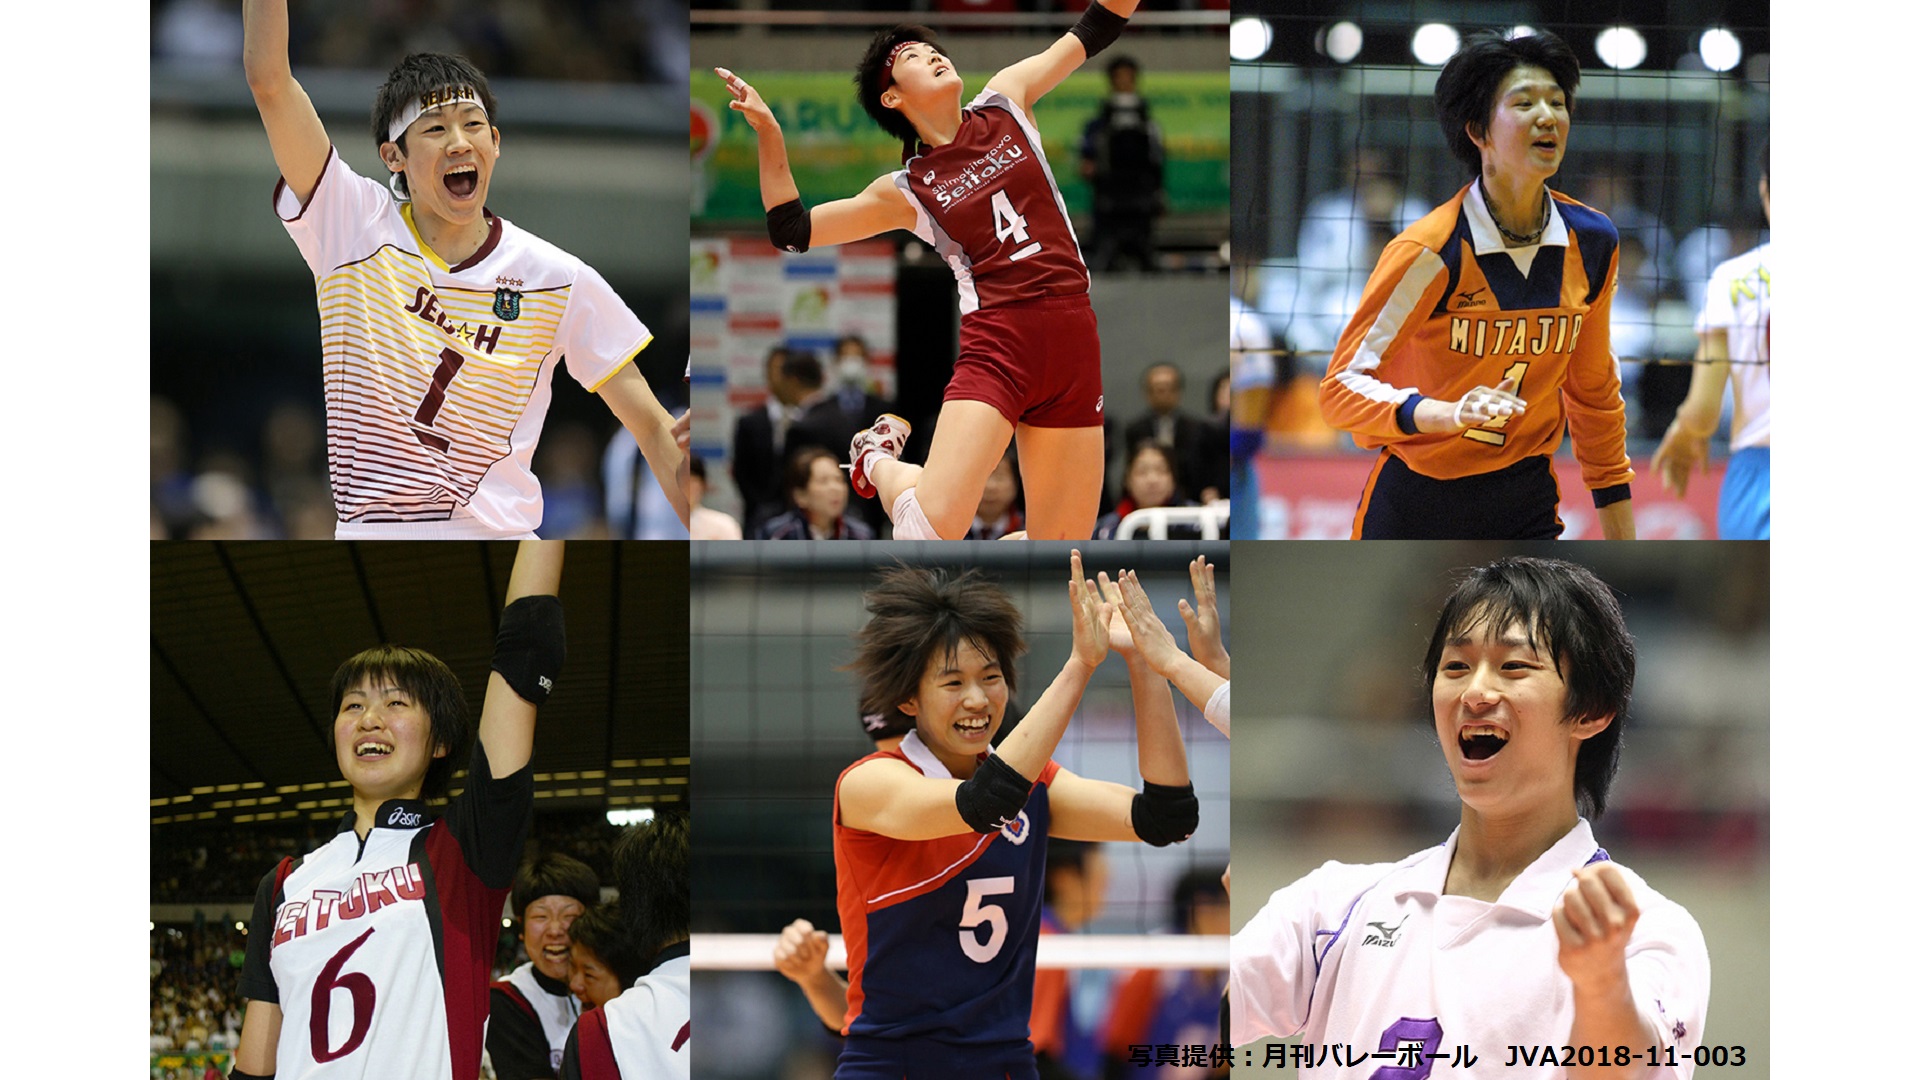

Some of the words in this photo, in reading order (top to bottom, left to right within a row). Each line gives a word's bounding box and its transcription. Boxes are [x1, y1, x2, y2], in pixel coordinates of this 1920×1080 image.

[936, 144, 1023, 208] Seitoku
[991, 188, 1030, 245] 4
[413, 346, 465, 428] 1
[1478, 360, 1530, 429] 1
[958, 875, 1015, 964] 5
[309, 925, 376, 1064] 6
